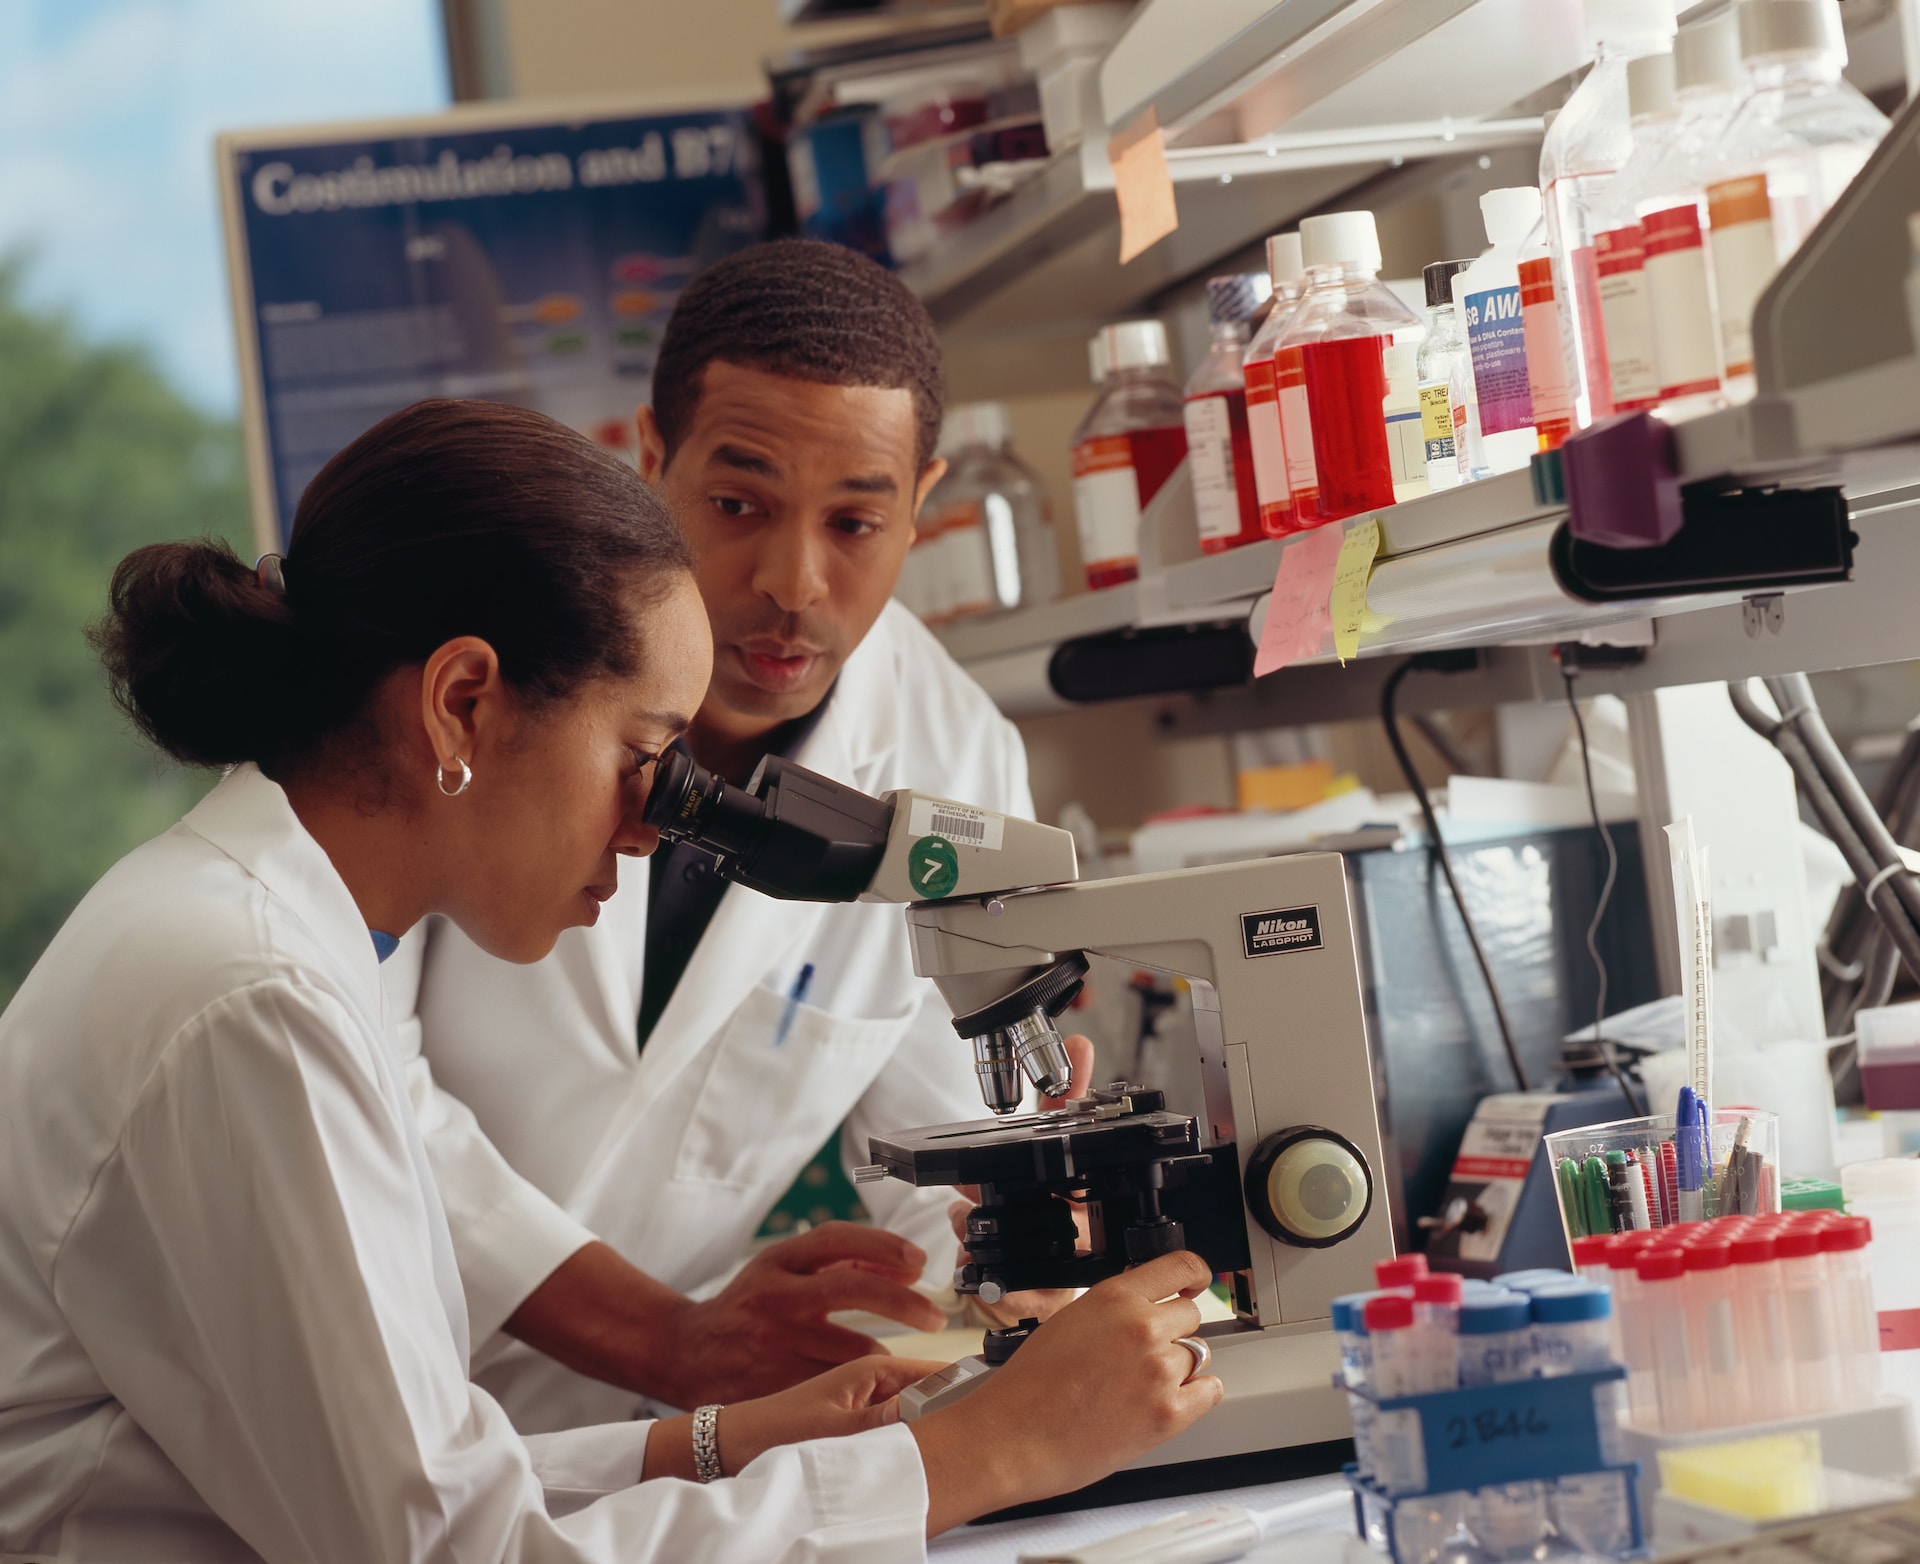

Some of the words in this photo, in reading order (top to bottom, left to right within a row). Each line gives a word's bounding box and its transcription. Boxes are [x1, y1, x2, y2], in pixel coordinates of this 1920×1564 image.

[577, 131, 666, 187] and
[932, 803, 961, 812] PROPERTY
[921, 858, 943, 884] 7
[1257, 919, 1308, 935] Nikon
[1253, 934, 1313, 948] LABOPHOT
